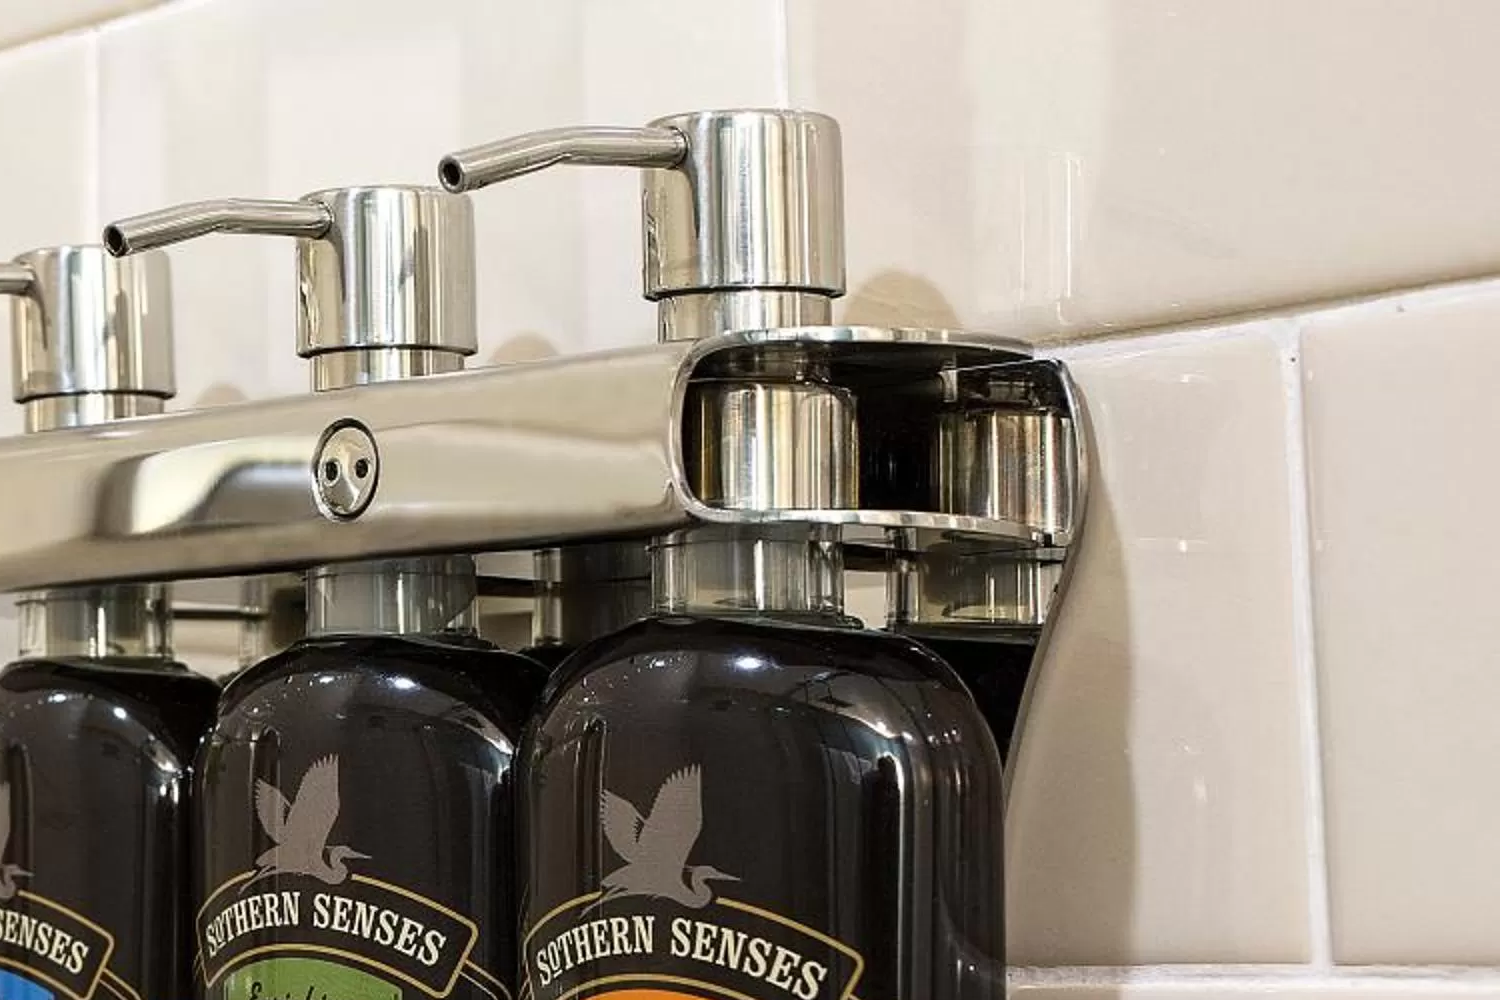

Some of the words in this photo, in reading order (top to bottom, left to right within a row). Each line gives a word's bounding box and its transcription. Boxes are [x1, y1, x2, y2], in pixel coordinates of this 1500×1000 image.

[312, 892, 447, 967] SENSES
[536, 915, 655, 987] SOTHERN
[670, 917, 827, 1000] SENSES
